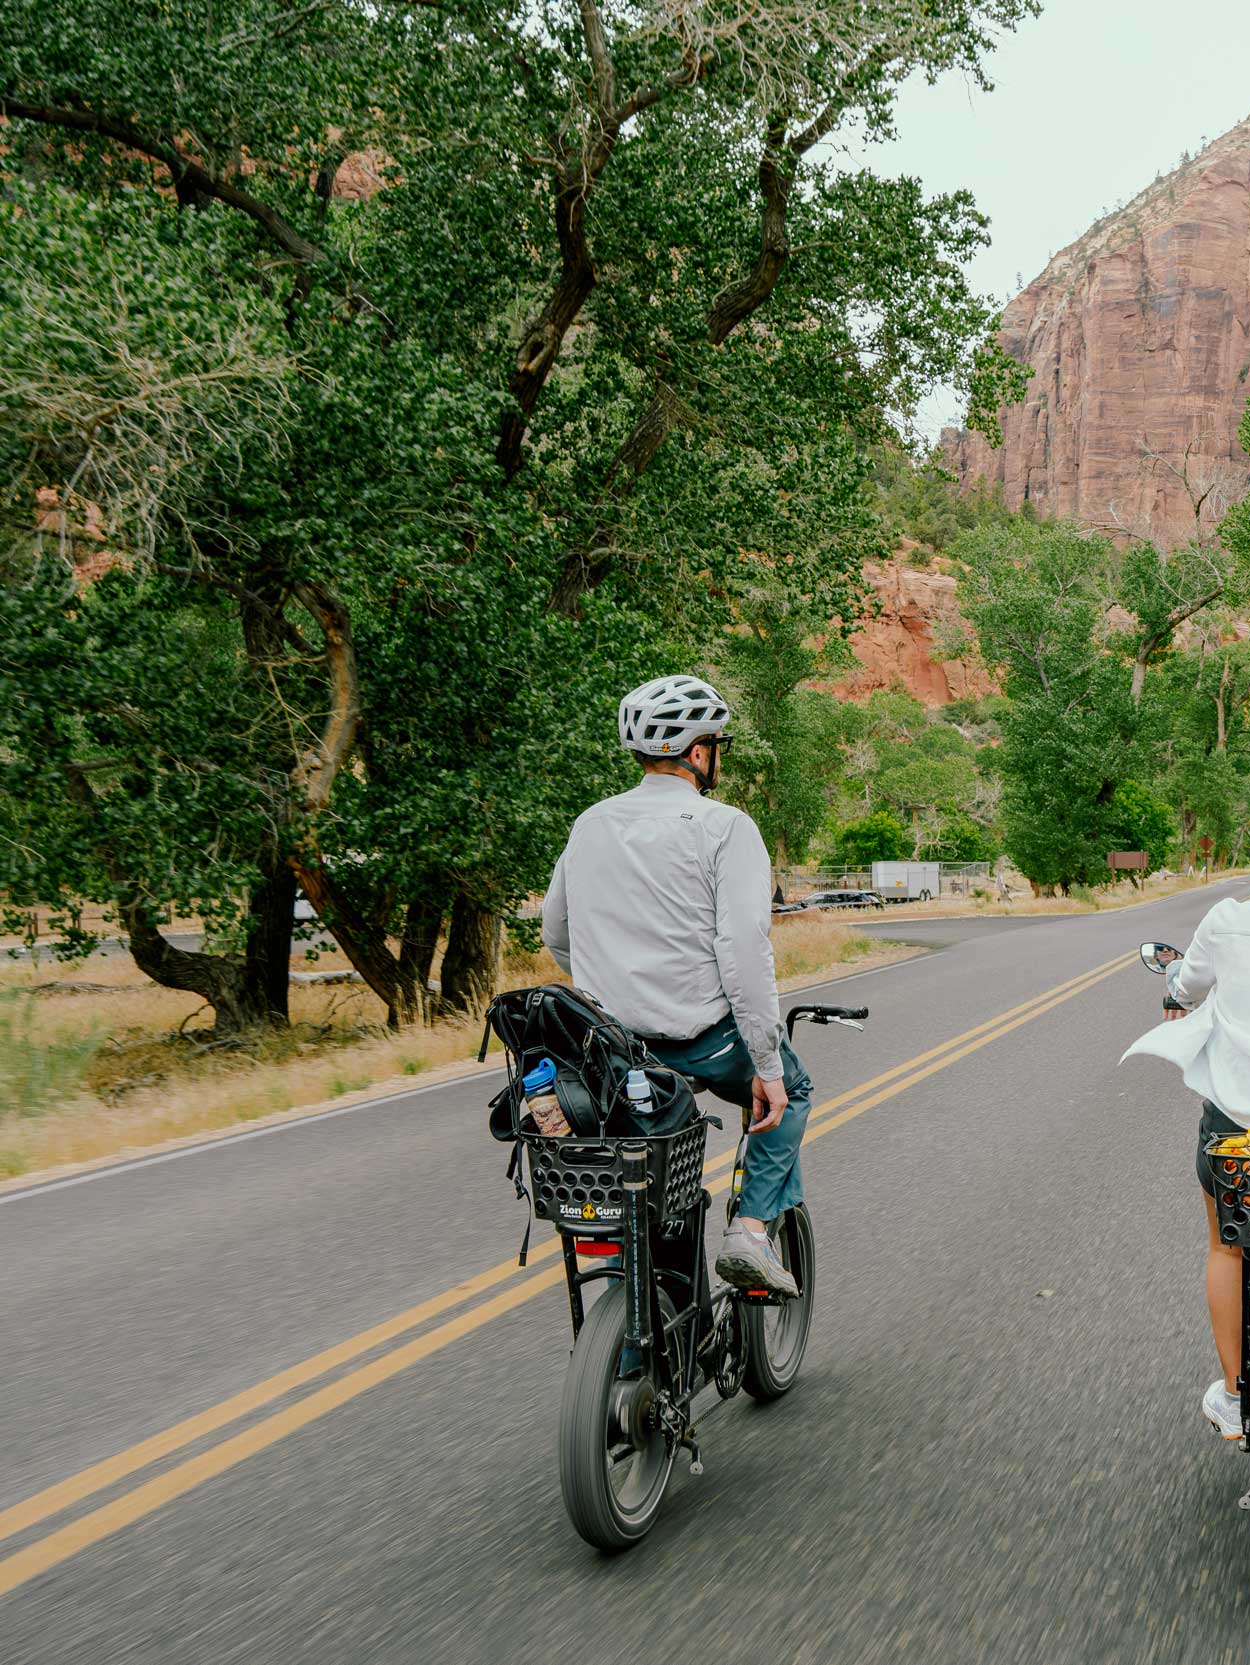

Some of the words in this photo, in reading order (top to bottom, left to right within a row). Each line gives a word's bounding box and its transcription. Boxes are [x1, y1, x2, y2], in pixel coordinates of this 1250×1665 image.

[560, 1205, 581, 1215] Zion
[596, 1207, 621, 1215] Guru
[665, 1220, 684, 1236] 27
